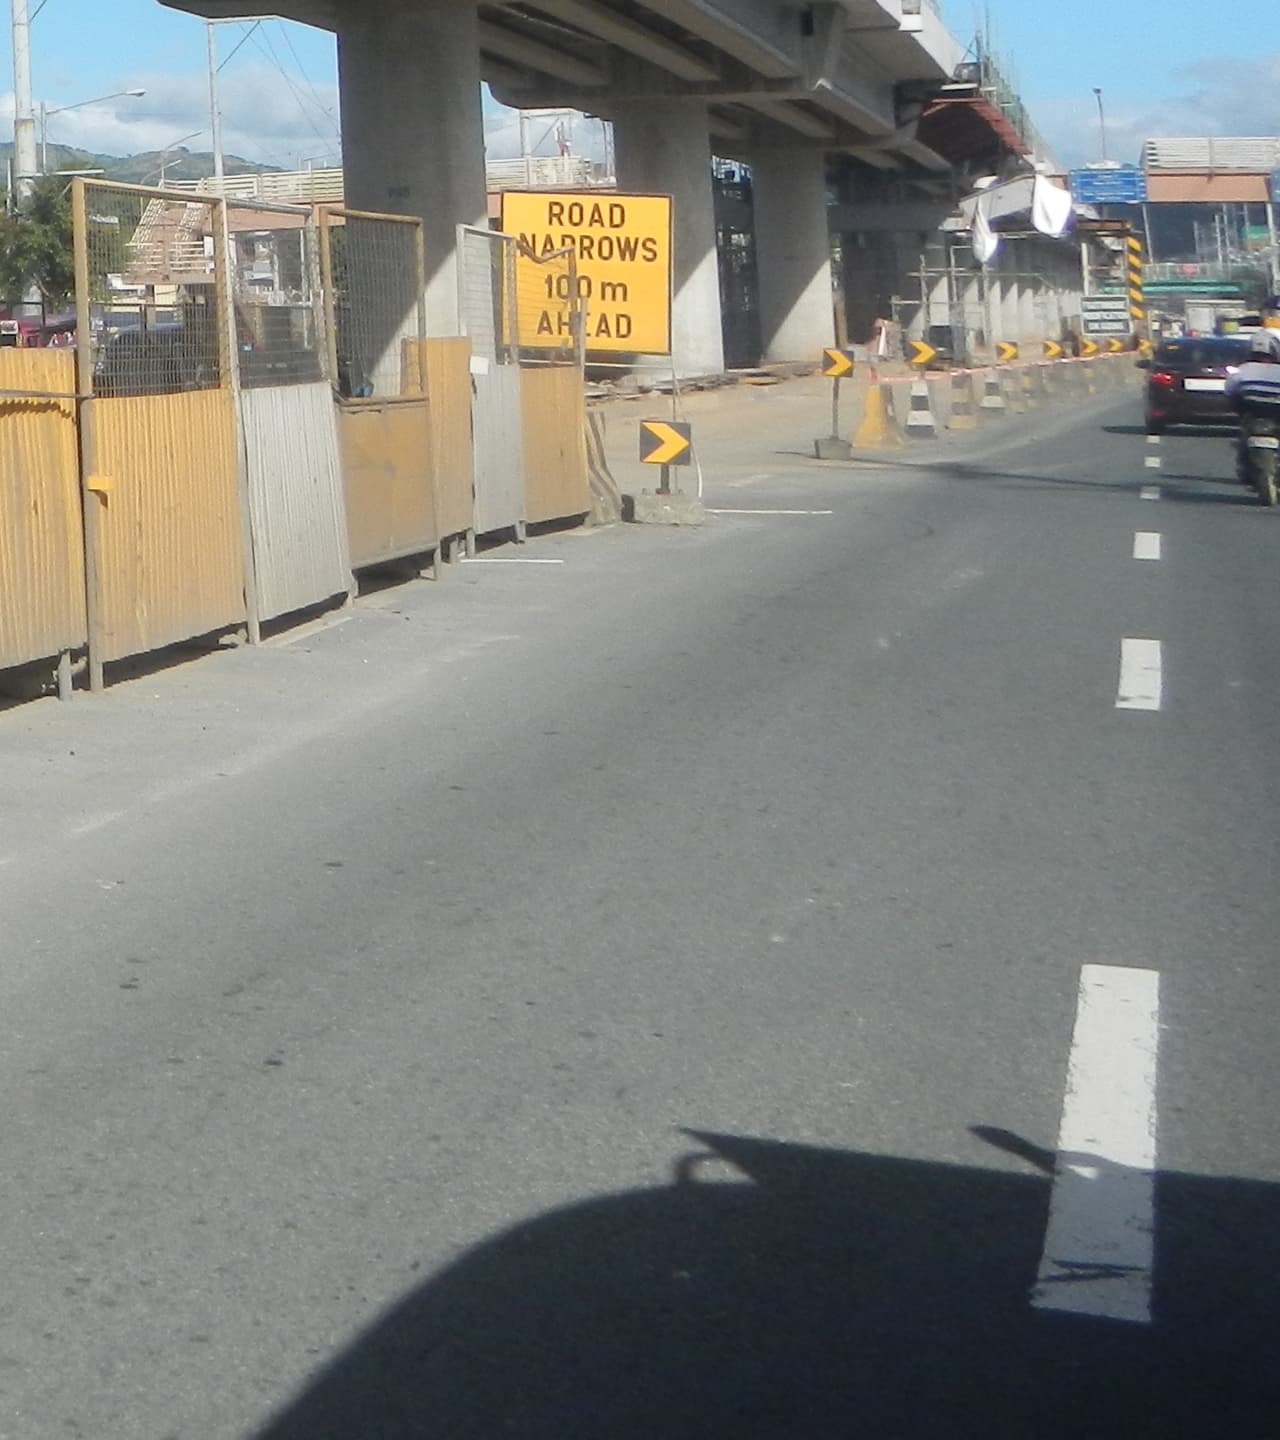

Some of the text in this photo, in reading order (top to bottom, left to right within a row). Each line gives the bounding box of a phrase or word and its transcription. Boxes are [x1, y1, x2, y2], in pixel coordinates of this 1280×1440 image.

[548, 201, 626, 228] ROAD
[519, 232, 658, 262] NARROWS
[545, 273, 628, 302] 100 m
[537, 310, 632, 338] AHAD
